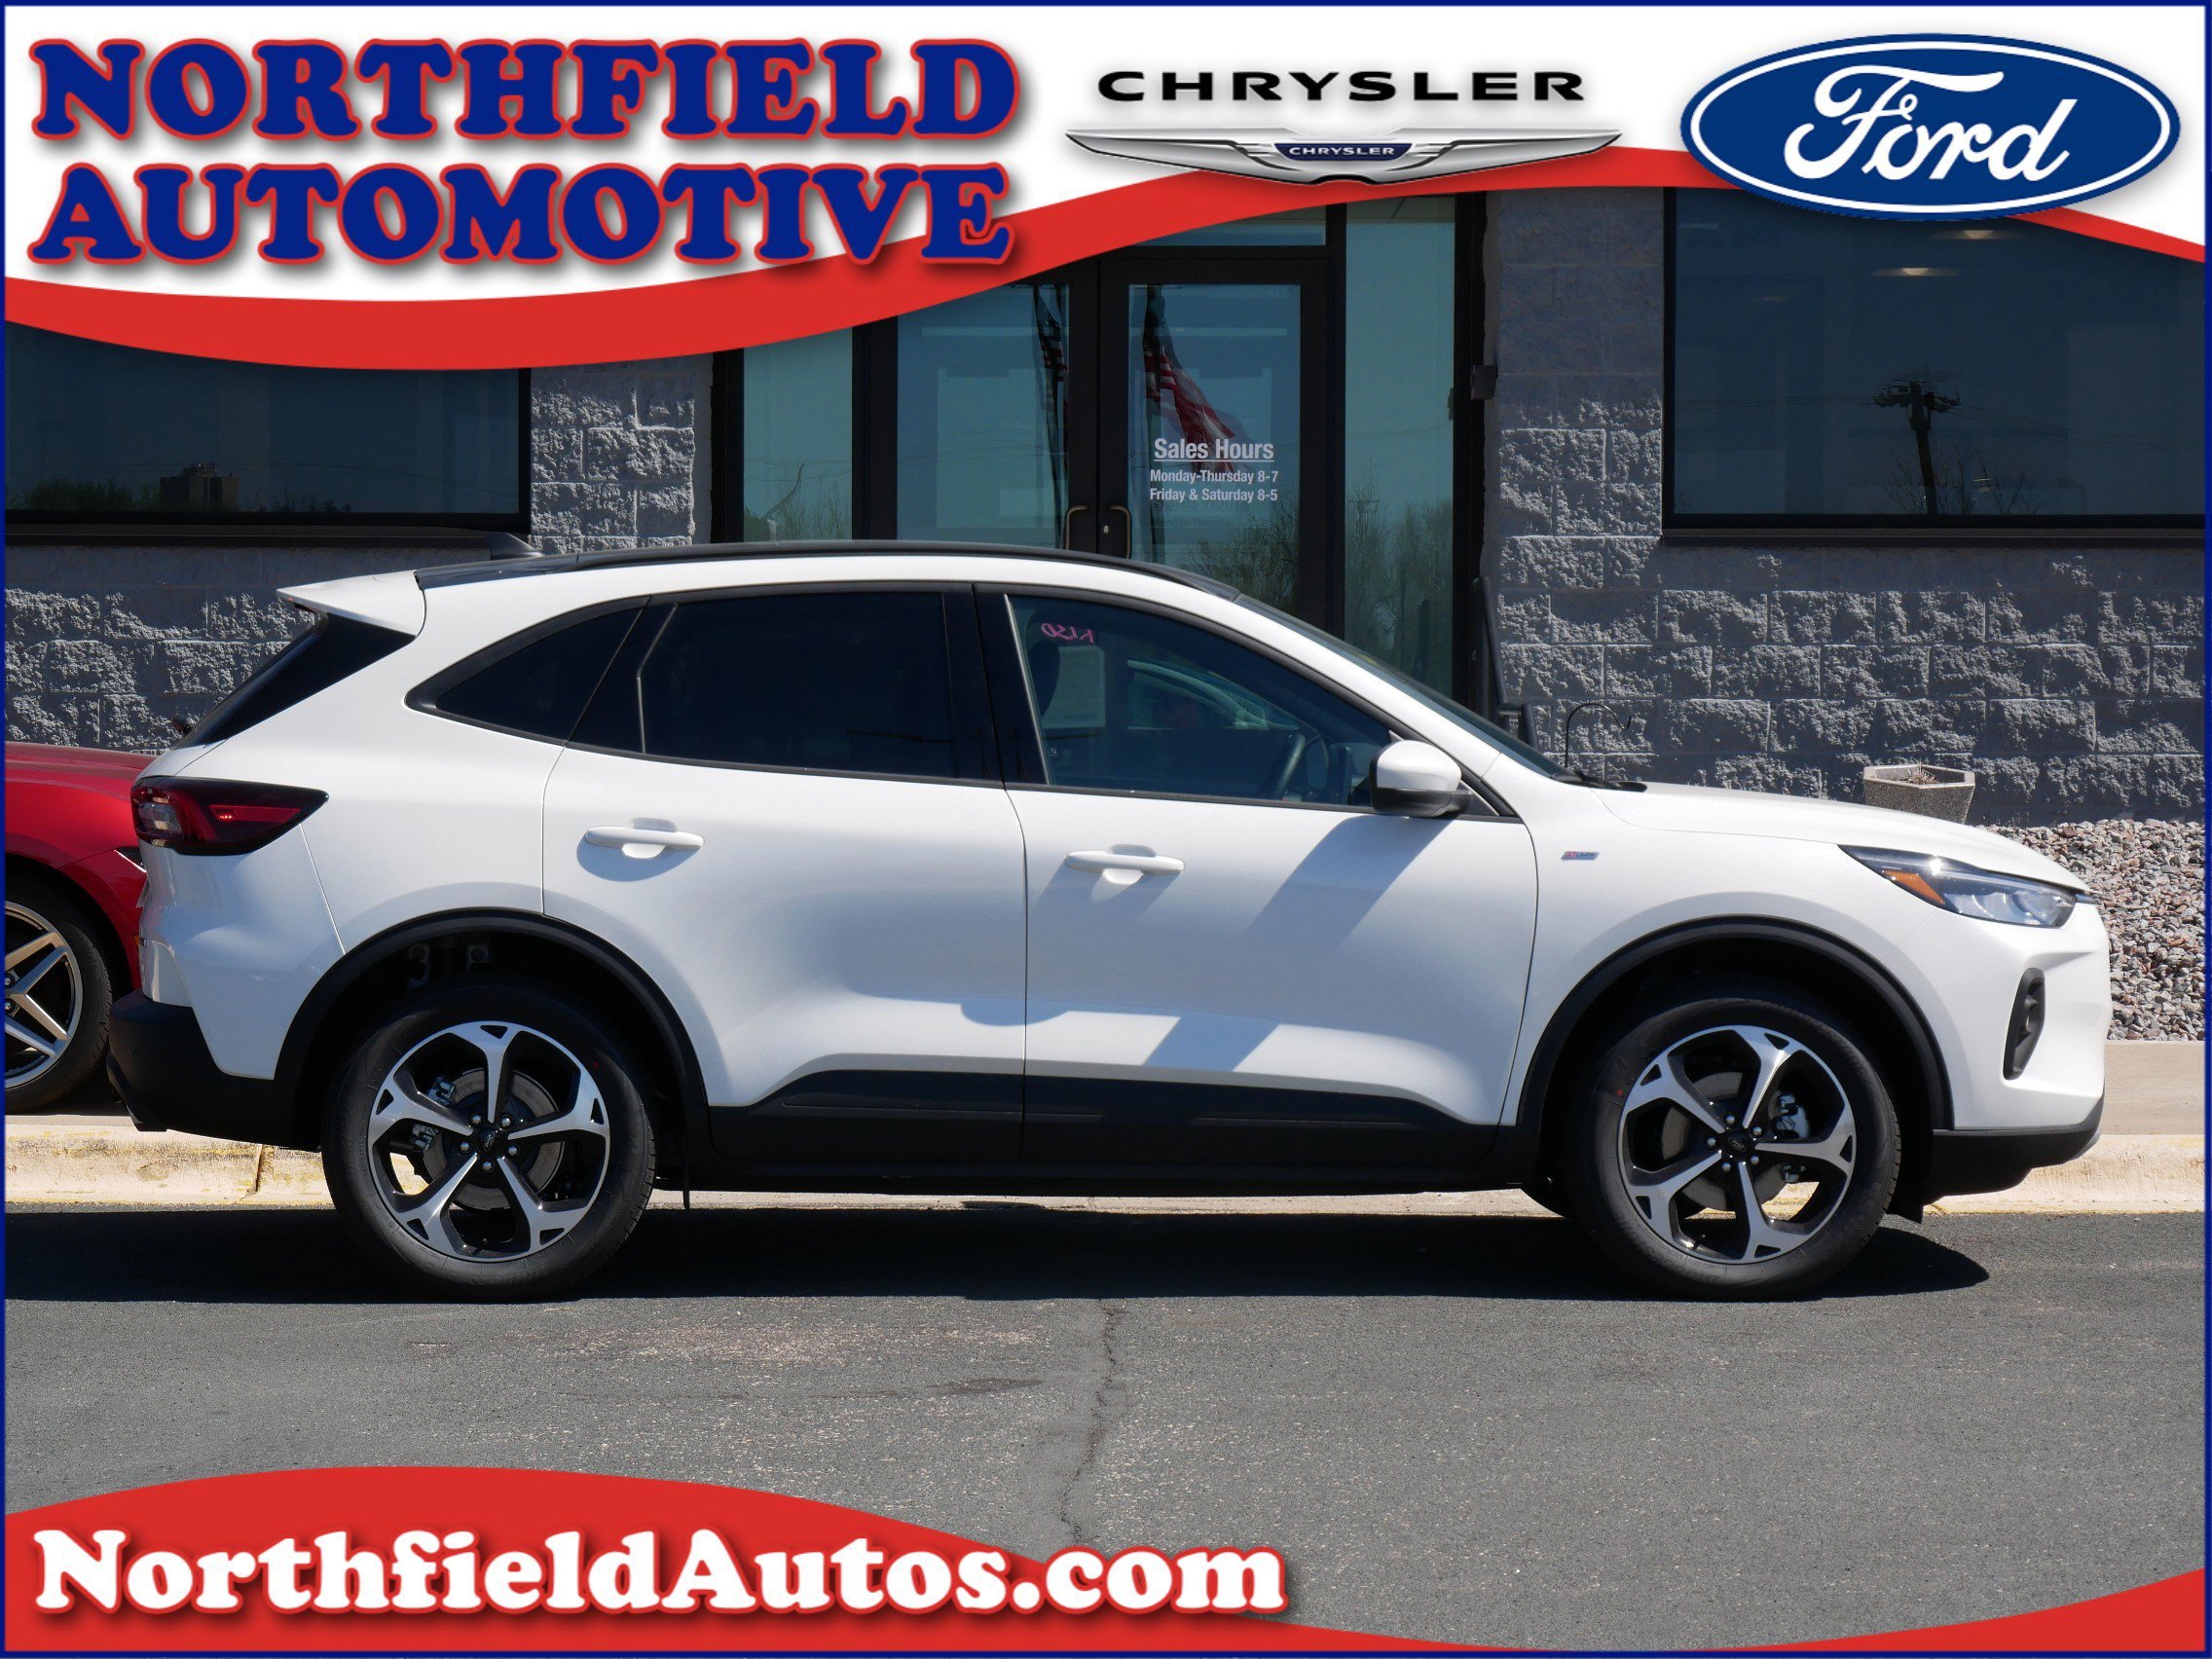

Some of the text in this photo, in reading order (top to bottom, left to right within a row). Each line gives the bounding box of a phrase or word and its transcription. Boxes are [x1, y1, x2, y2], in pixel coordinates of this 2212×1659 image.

[1154, 438, 1274, 460] Sales Hours
[1150, 469, 1278, 484] Monday-Thursday 8-7
[1150, 488, 1278, 503] Friday & Saturday 8-5
